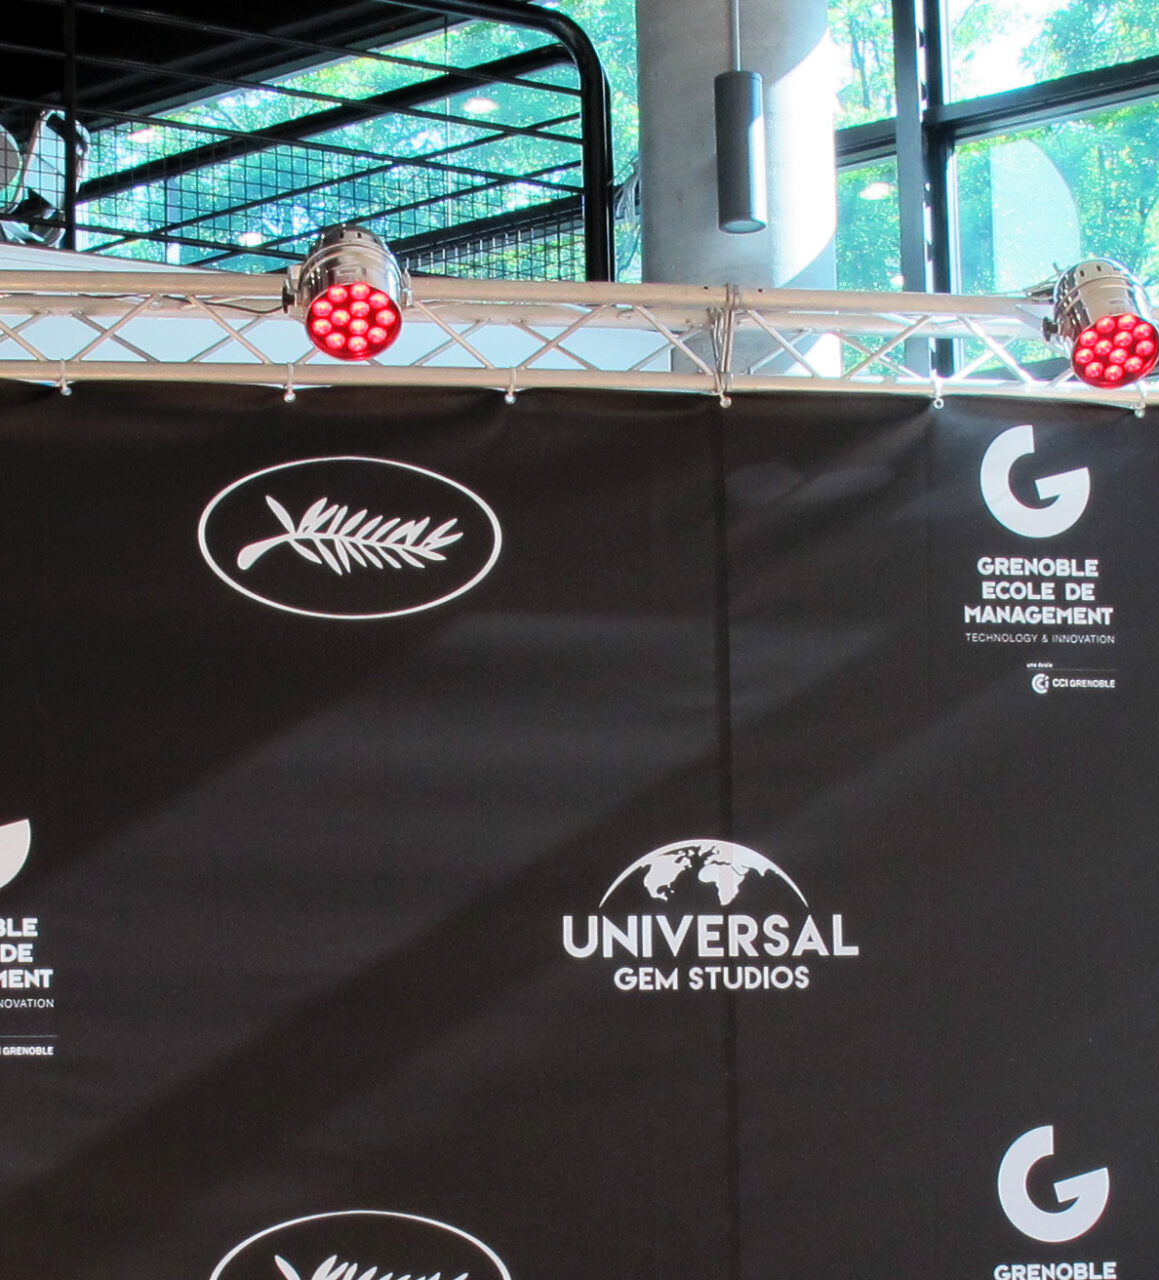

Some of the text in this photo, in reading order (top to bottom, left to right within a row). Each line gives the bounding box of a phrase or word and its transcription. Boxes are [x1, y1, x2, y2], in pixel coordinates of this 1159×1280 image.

[976, 556, 1099, 577] GRENOBLE
[981, 581, 1095, 601] ECOLE DE
[964, 605, 1114, 625] MANAGEMENT
[965, 632, 1115, 644] TECHNOLOGY & INNOVATION
[1052, 678, 1115, 688] CCI GRENOBLE
[562, 913, 859, 958] UNIVERSAL
[614, 966, 810, 990] GEM STUDIOS
[2, 1046, 54, 1056] GRENOBLE
